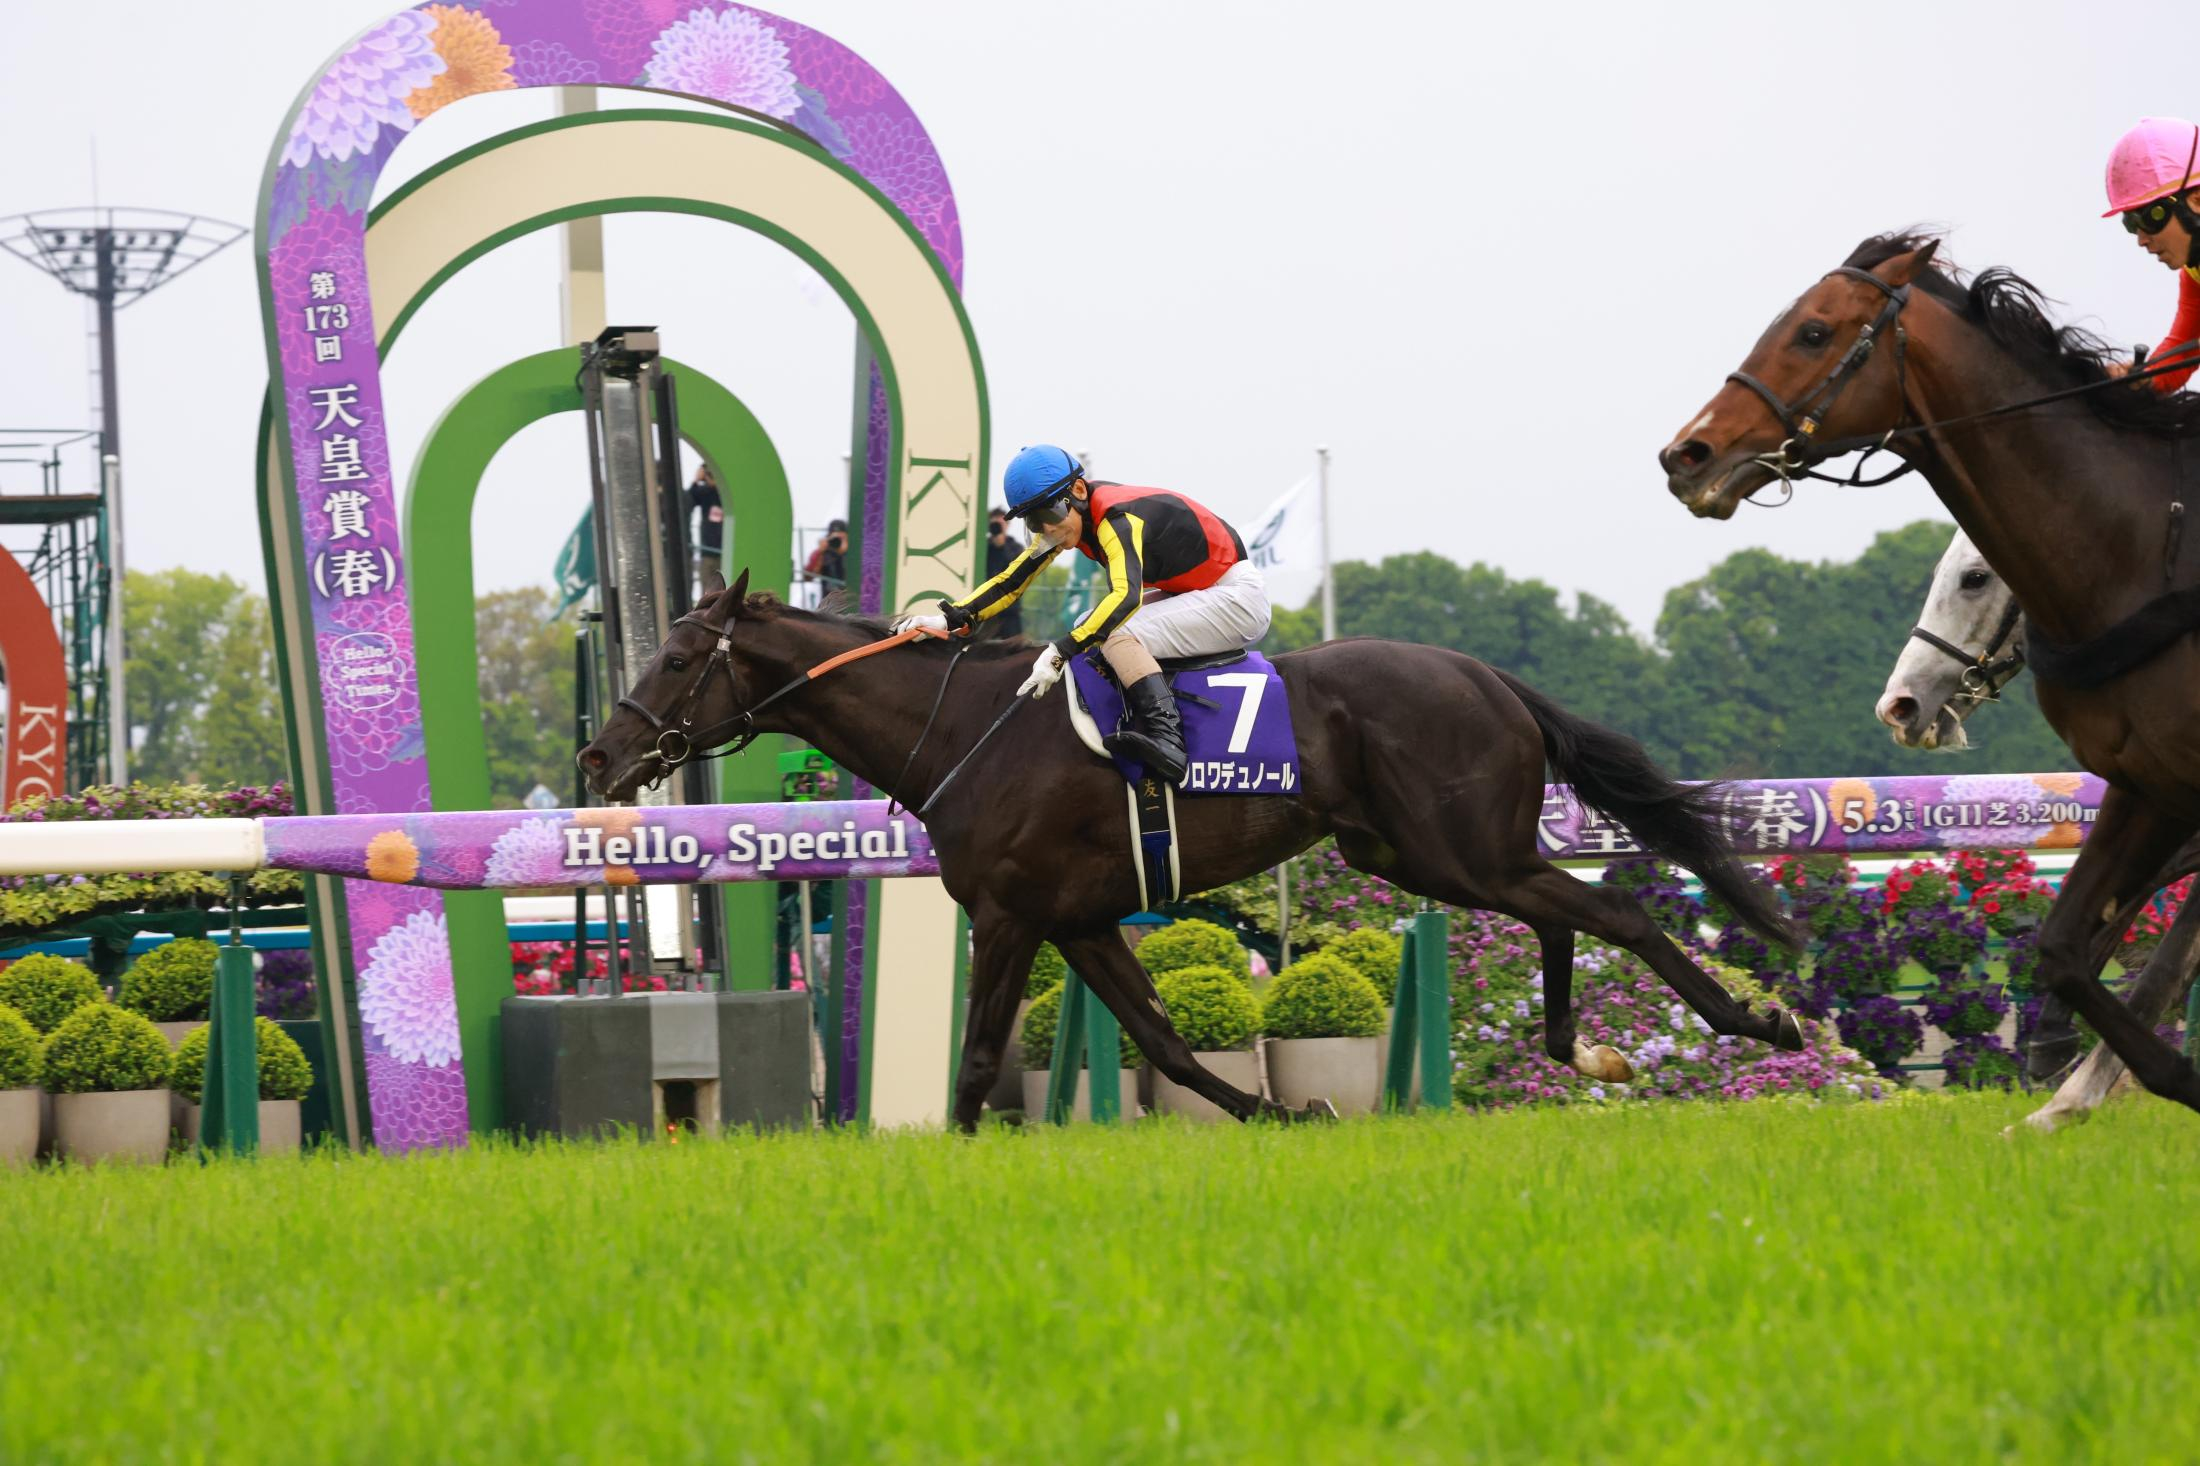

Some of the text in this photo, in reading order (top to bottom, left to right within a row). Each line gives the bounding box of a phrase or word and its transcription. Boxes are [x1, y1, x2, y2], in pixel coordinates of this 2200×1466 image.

[1206, 672, 1269, 753] 7
[1842, 799, 1903, 834] 5.3
[1987, 801, 2011, 826] 芝
[563, 825, 715, 869] Hello,
[727, 820, 909, 872] Special
